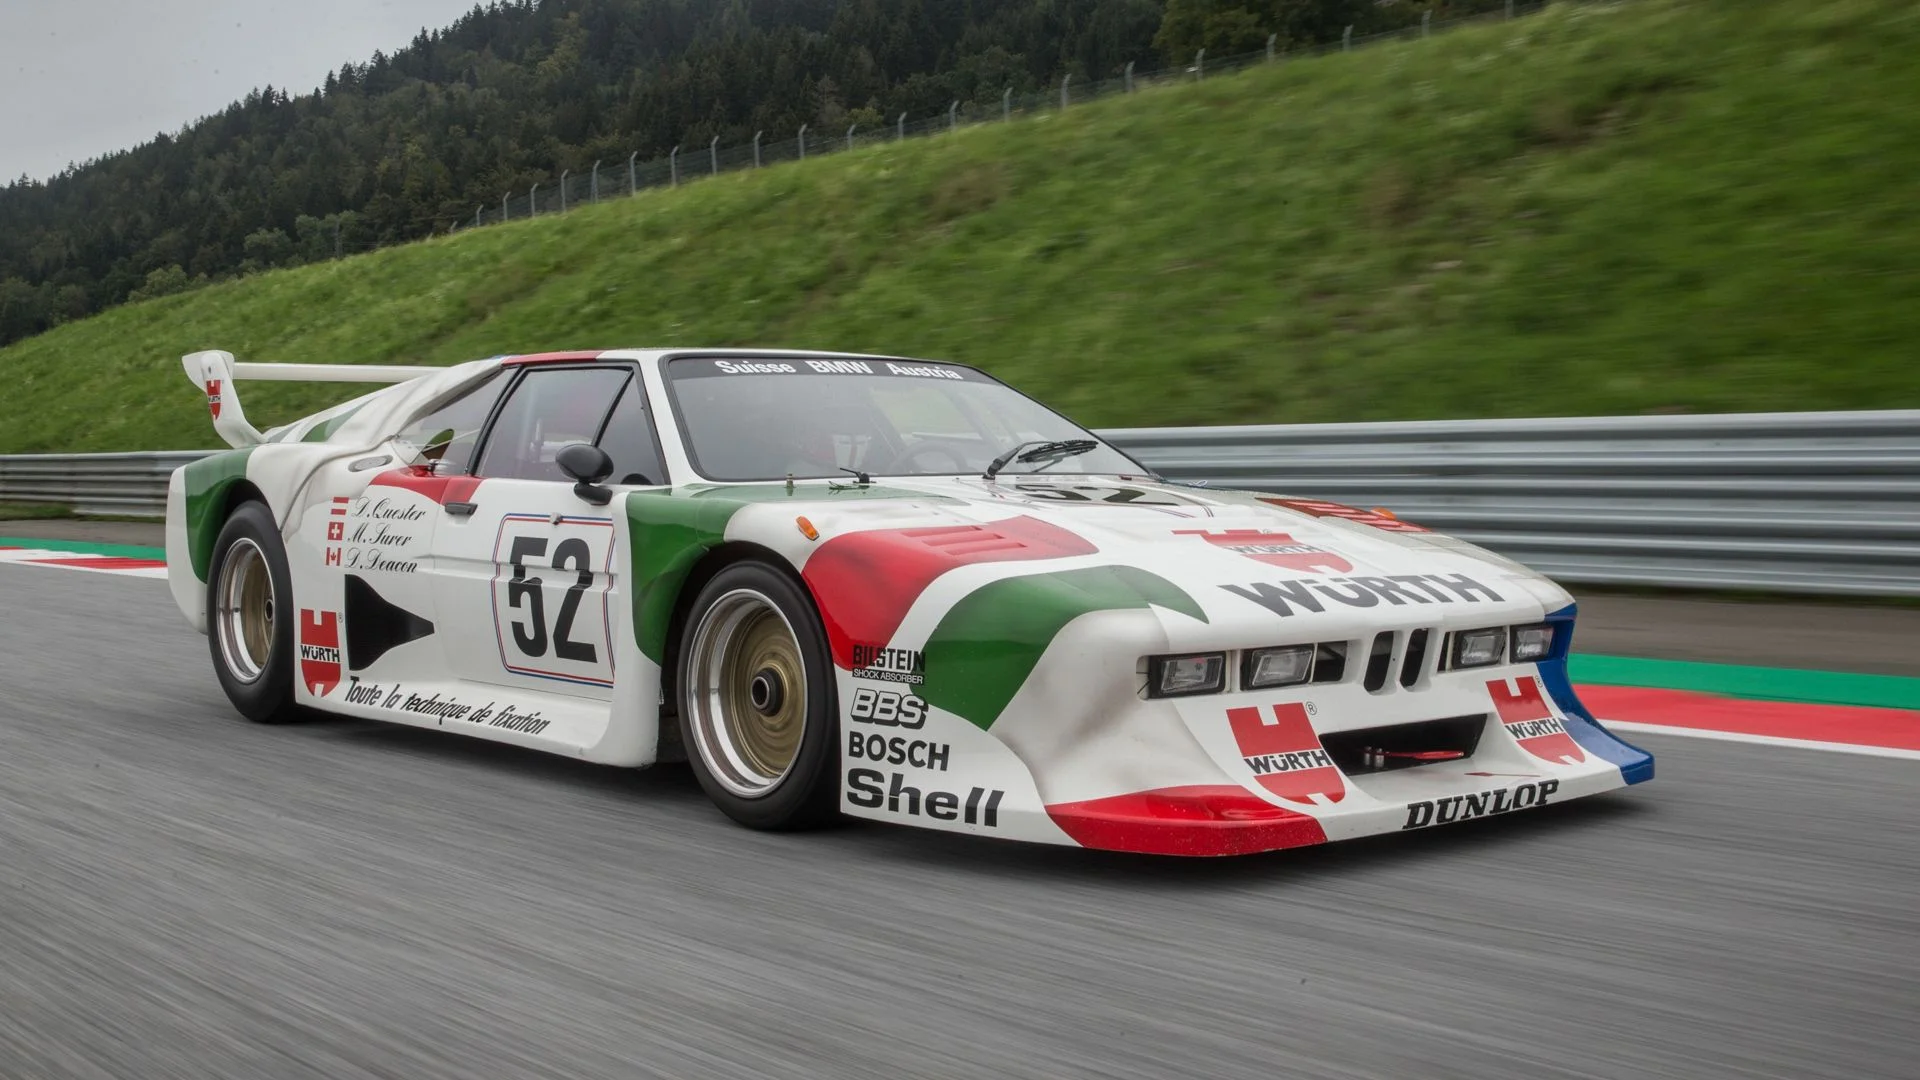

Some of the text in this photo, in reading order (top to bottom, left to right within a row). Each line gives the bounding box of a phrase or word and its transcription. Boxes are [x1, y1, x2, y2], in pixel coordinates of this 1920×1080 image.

[714, 360, 963, 380] Suisse BMW Austria
[508, 536, 598, 663] 52
[1217, 573, 1506, 618] WÜRTH
[300, 644, 340, 663] WÜRTH
[853, 645, 926, 673] BILSTEIN
[853, 668, 924, 685] SHOCK ABSORBER
[344, 675, 551, 735] Toute la technique de fixation
[851, 688, 929, 730] BBS
[1504, 719, 1564, 740] WÜRTH
[848, 731, 950, 771] BOSCH
[1243, 749, 1333, 775] WÜRTH
[847, 767, 1005, 828] Shell
[1401, 778, 1560, 830] DUNLOP
